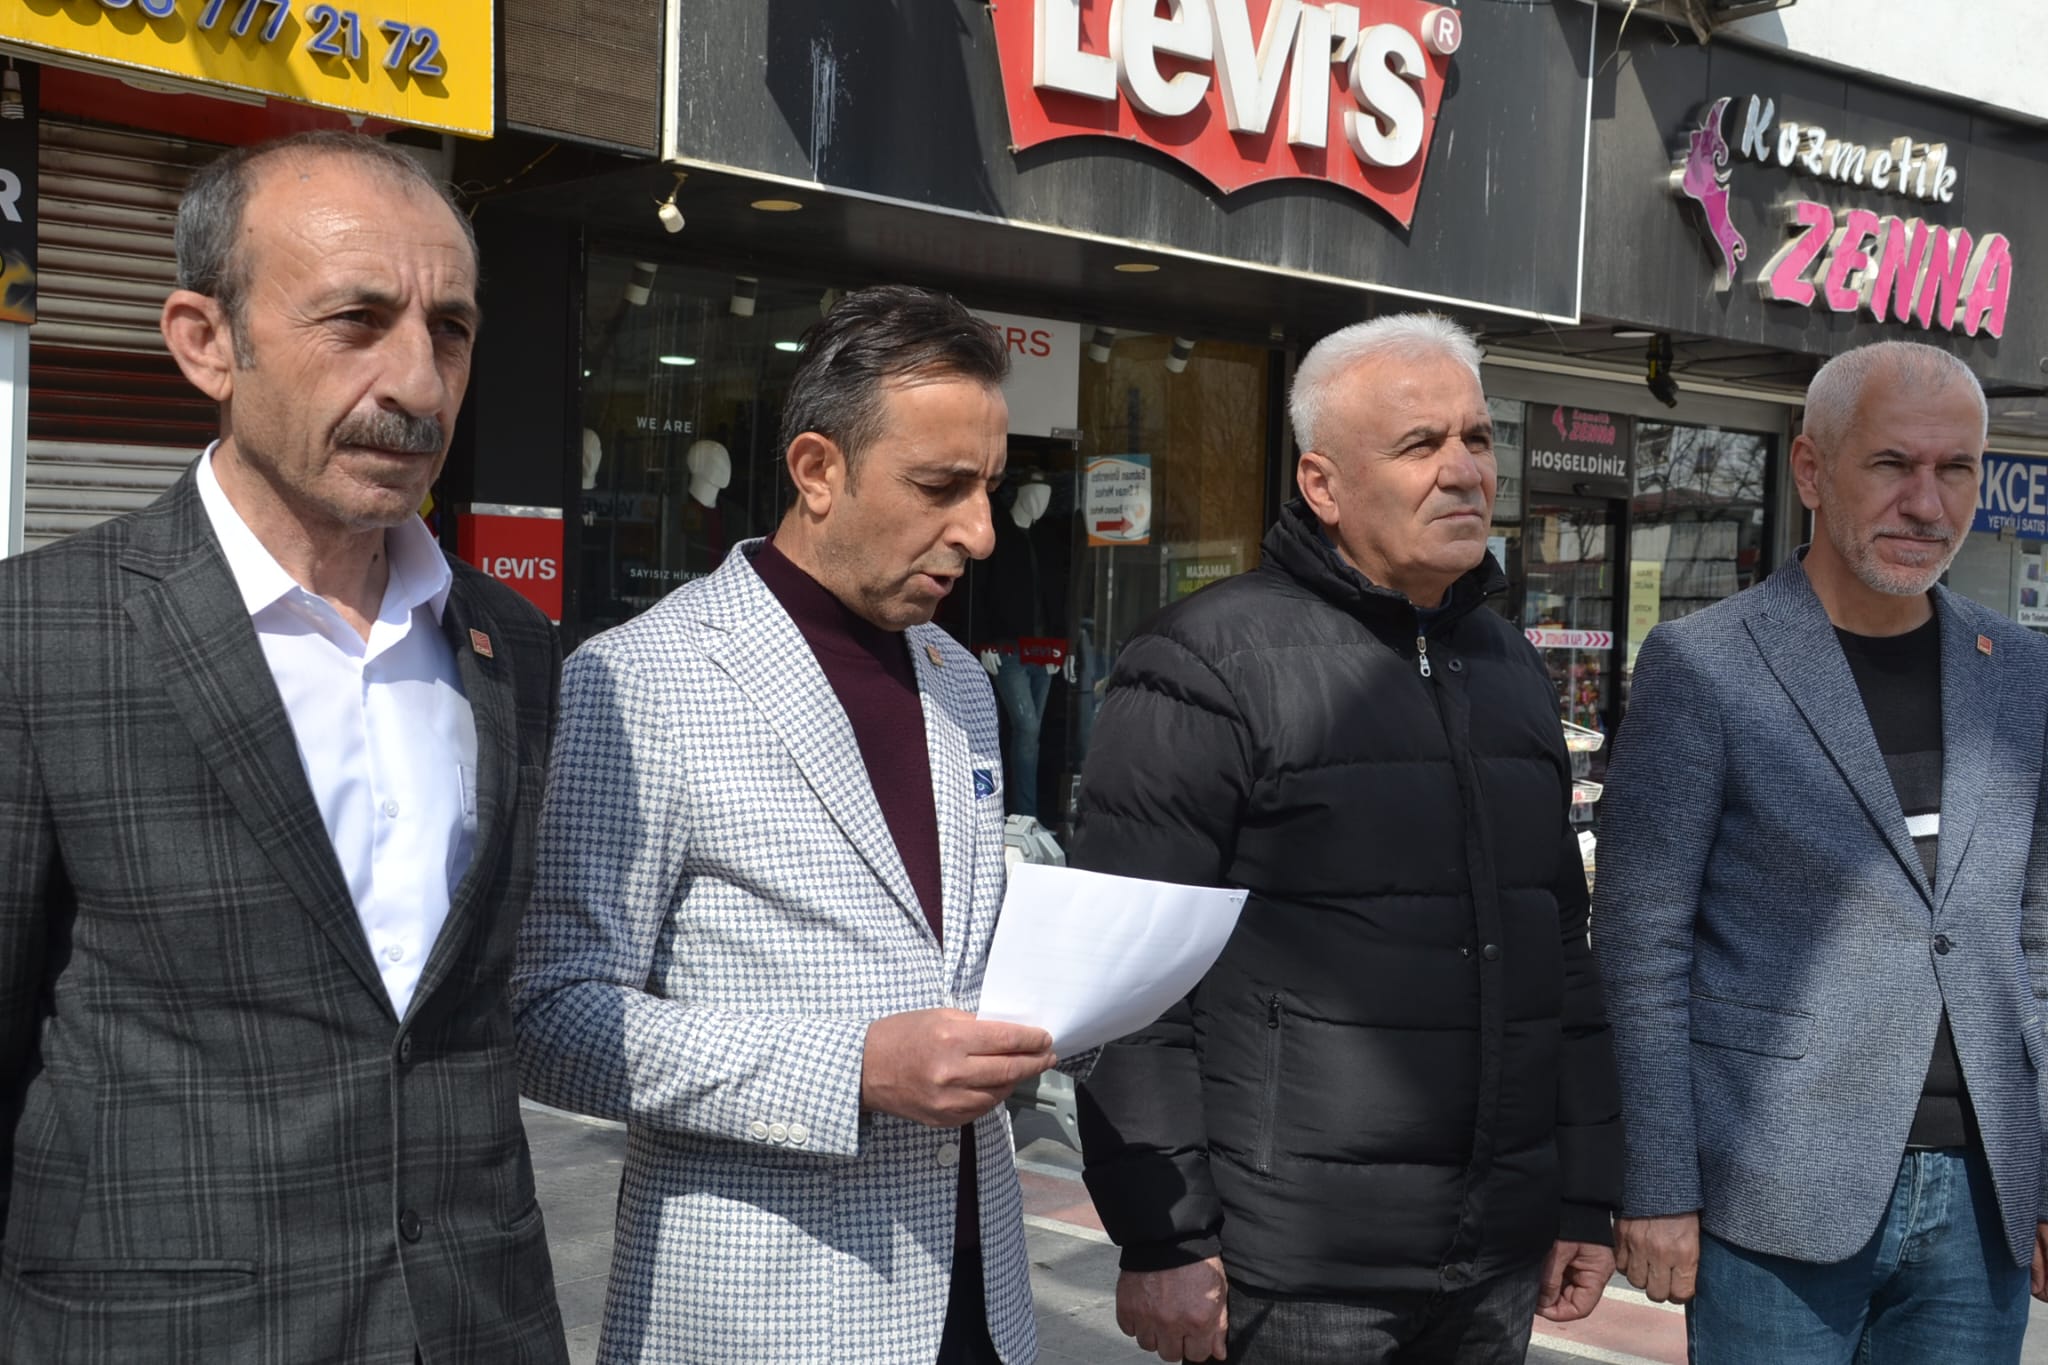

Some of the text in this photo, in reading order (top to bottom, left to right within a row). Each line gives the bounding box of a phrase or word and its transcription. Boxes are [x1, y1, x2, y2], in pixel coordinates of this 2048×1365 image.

[305, 3, 362, 60] 21
[379, 19, 443, 76] 72
[1741, 93, 1958, 204] Kozmetik
[1765, 200, 2013, 340] ZENNA
[991, 325, 1051, 357] RS
[636, 415, 693, 434] WE ARE
[1531, 449, 1627, 477] HOŞGELDİNİZ
[2021, 517, 2046, 536] SATIŞ
[630, 568, 670, 581] SAYISIZ
